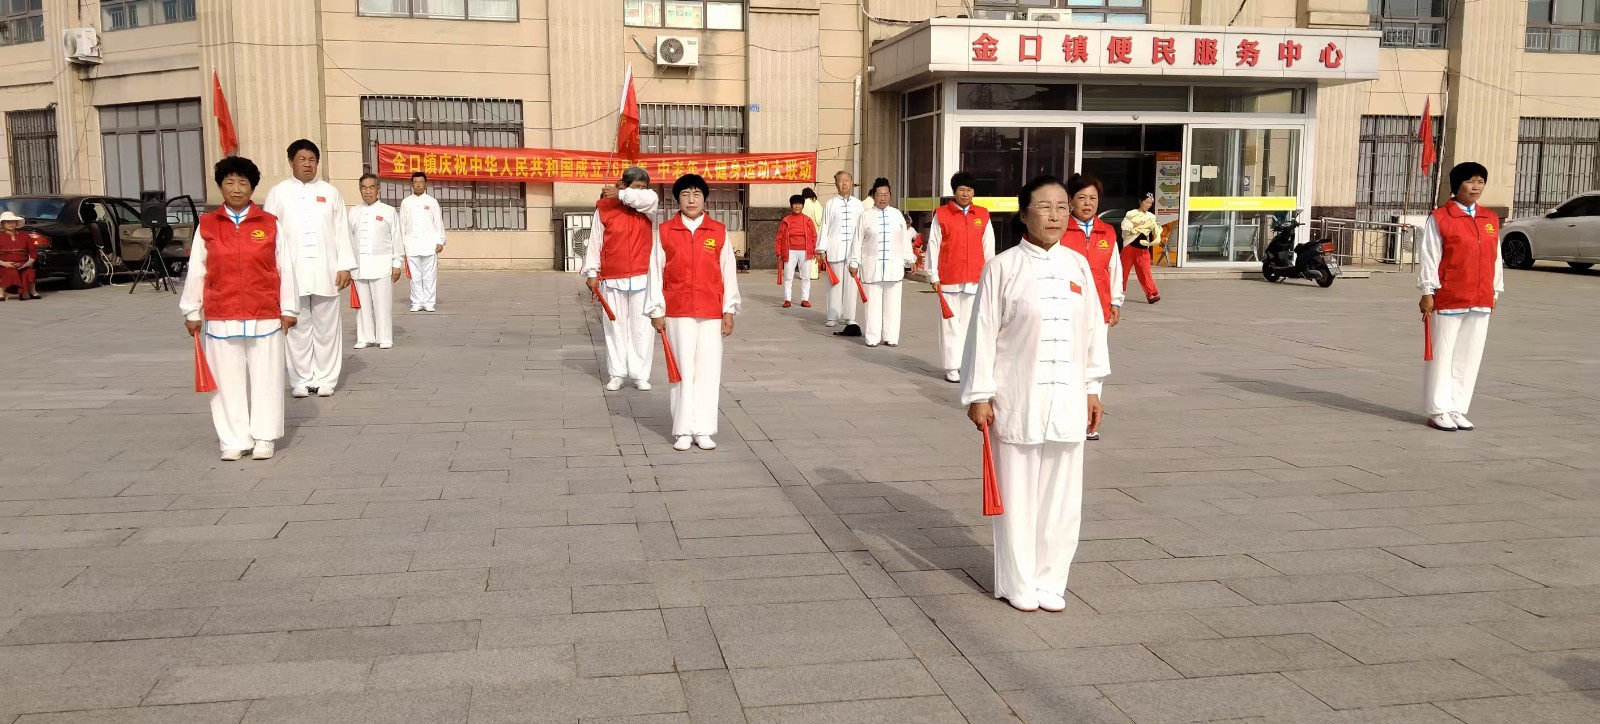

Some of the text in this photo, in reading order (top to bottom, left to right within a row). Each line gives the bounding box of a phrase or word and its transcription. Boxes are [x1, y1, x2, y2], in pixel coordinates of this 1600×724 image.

[971, 32, 1344, 68] 金口镇便民服务中心
[657, 158, 812, 181] 中老年人健身运动大联动
